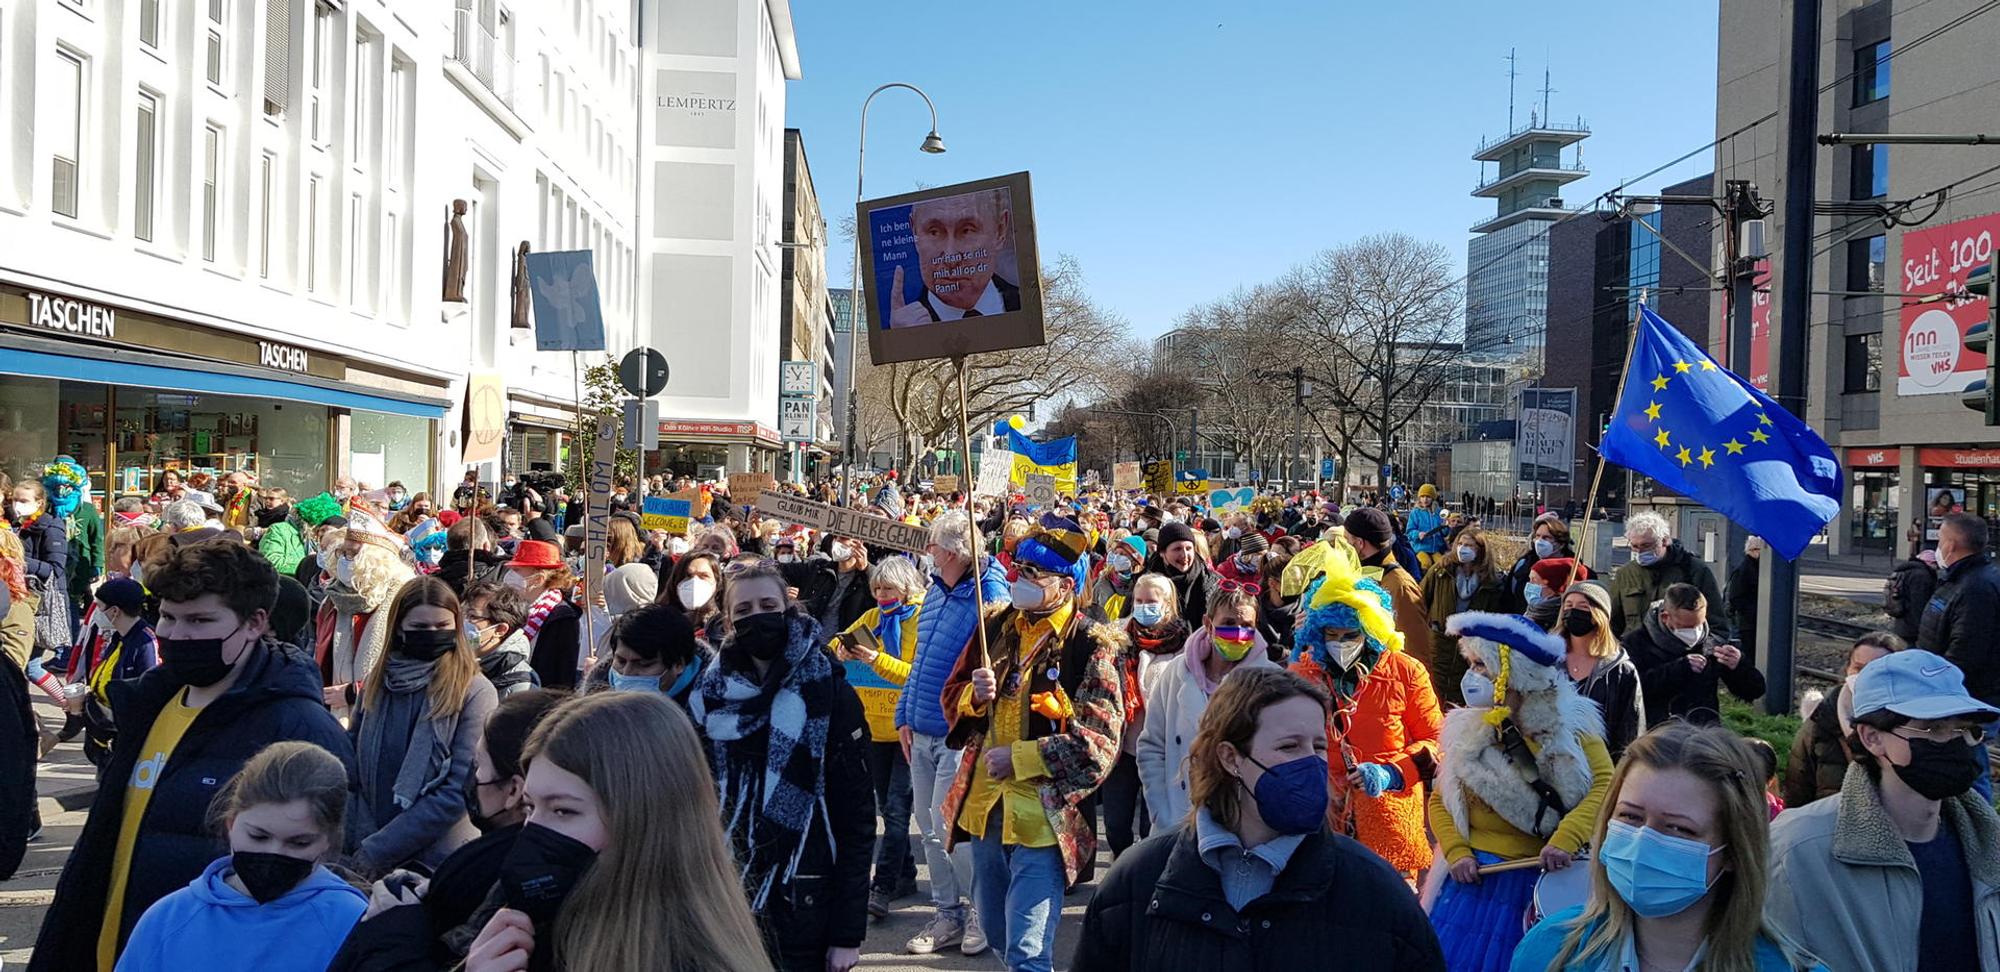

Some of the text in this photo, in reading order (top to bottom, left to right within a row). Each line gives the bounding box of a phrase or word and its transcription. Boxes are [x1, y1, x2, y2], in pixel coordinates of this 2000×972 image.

[658, 96, 736, 110] LEMPERTZ
[880, 222, 910, 233] Ich ben
[881, 234, 919, 247] ne kleine
[883, 251, 907, 261] Mann
[1905, 230, 1992, 292] Seit 100
[964, 265, 976, 277] op
[28, 293, 115, 338] TASCHEN
[259, 341, 308, 372] TASCHEN
[1931, 358, 1951, 374] VHS
[785, 402, 810, 413] PAN
[736, 425, 754, 434] MSP
[1867, 452, 1884, 464] VHS
[589, 460, 613, 560] SHALOM
[647, 500, 689, 514] UKRAINE
[777, 500, 804, 515] GLAUB
[826, 509, 848, 532] DIE
[849, 514, 887, 541] LIEBE
